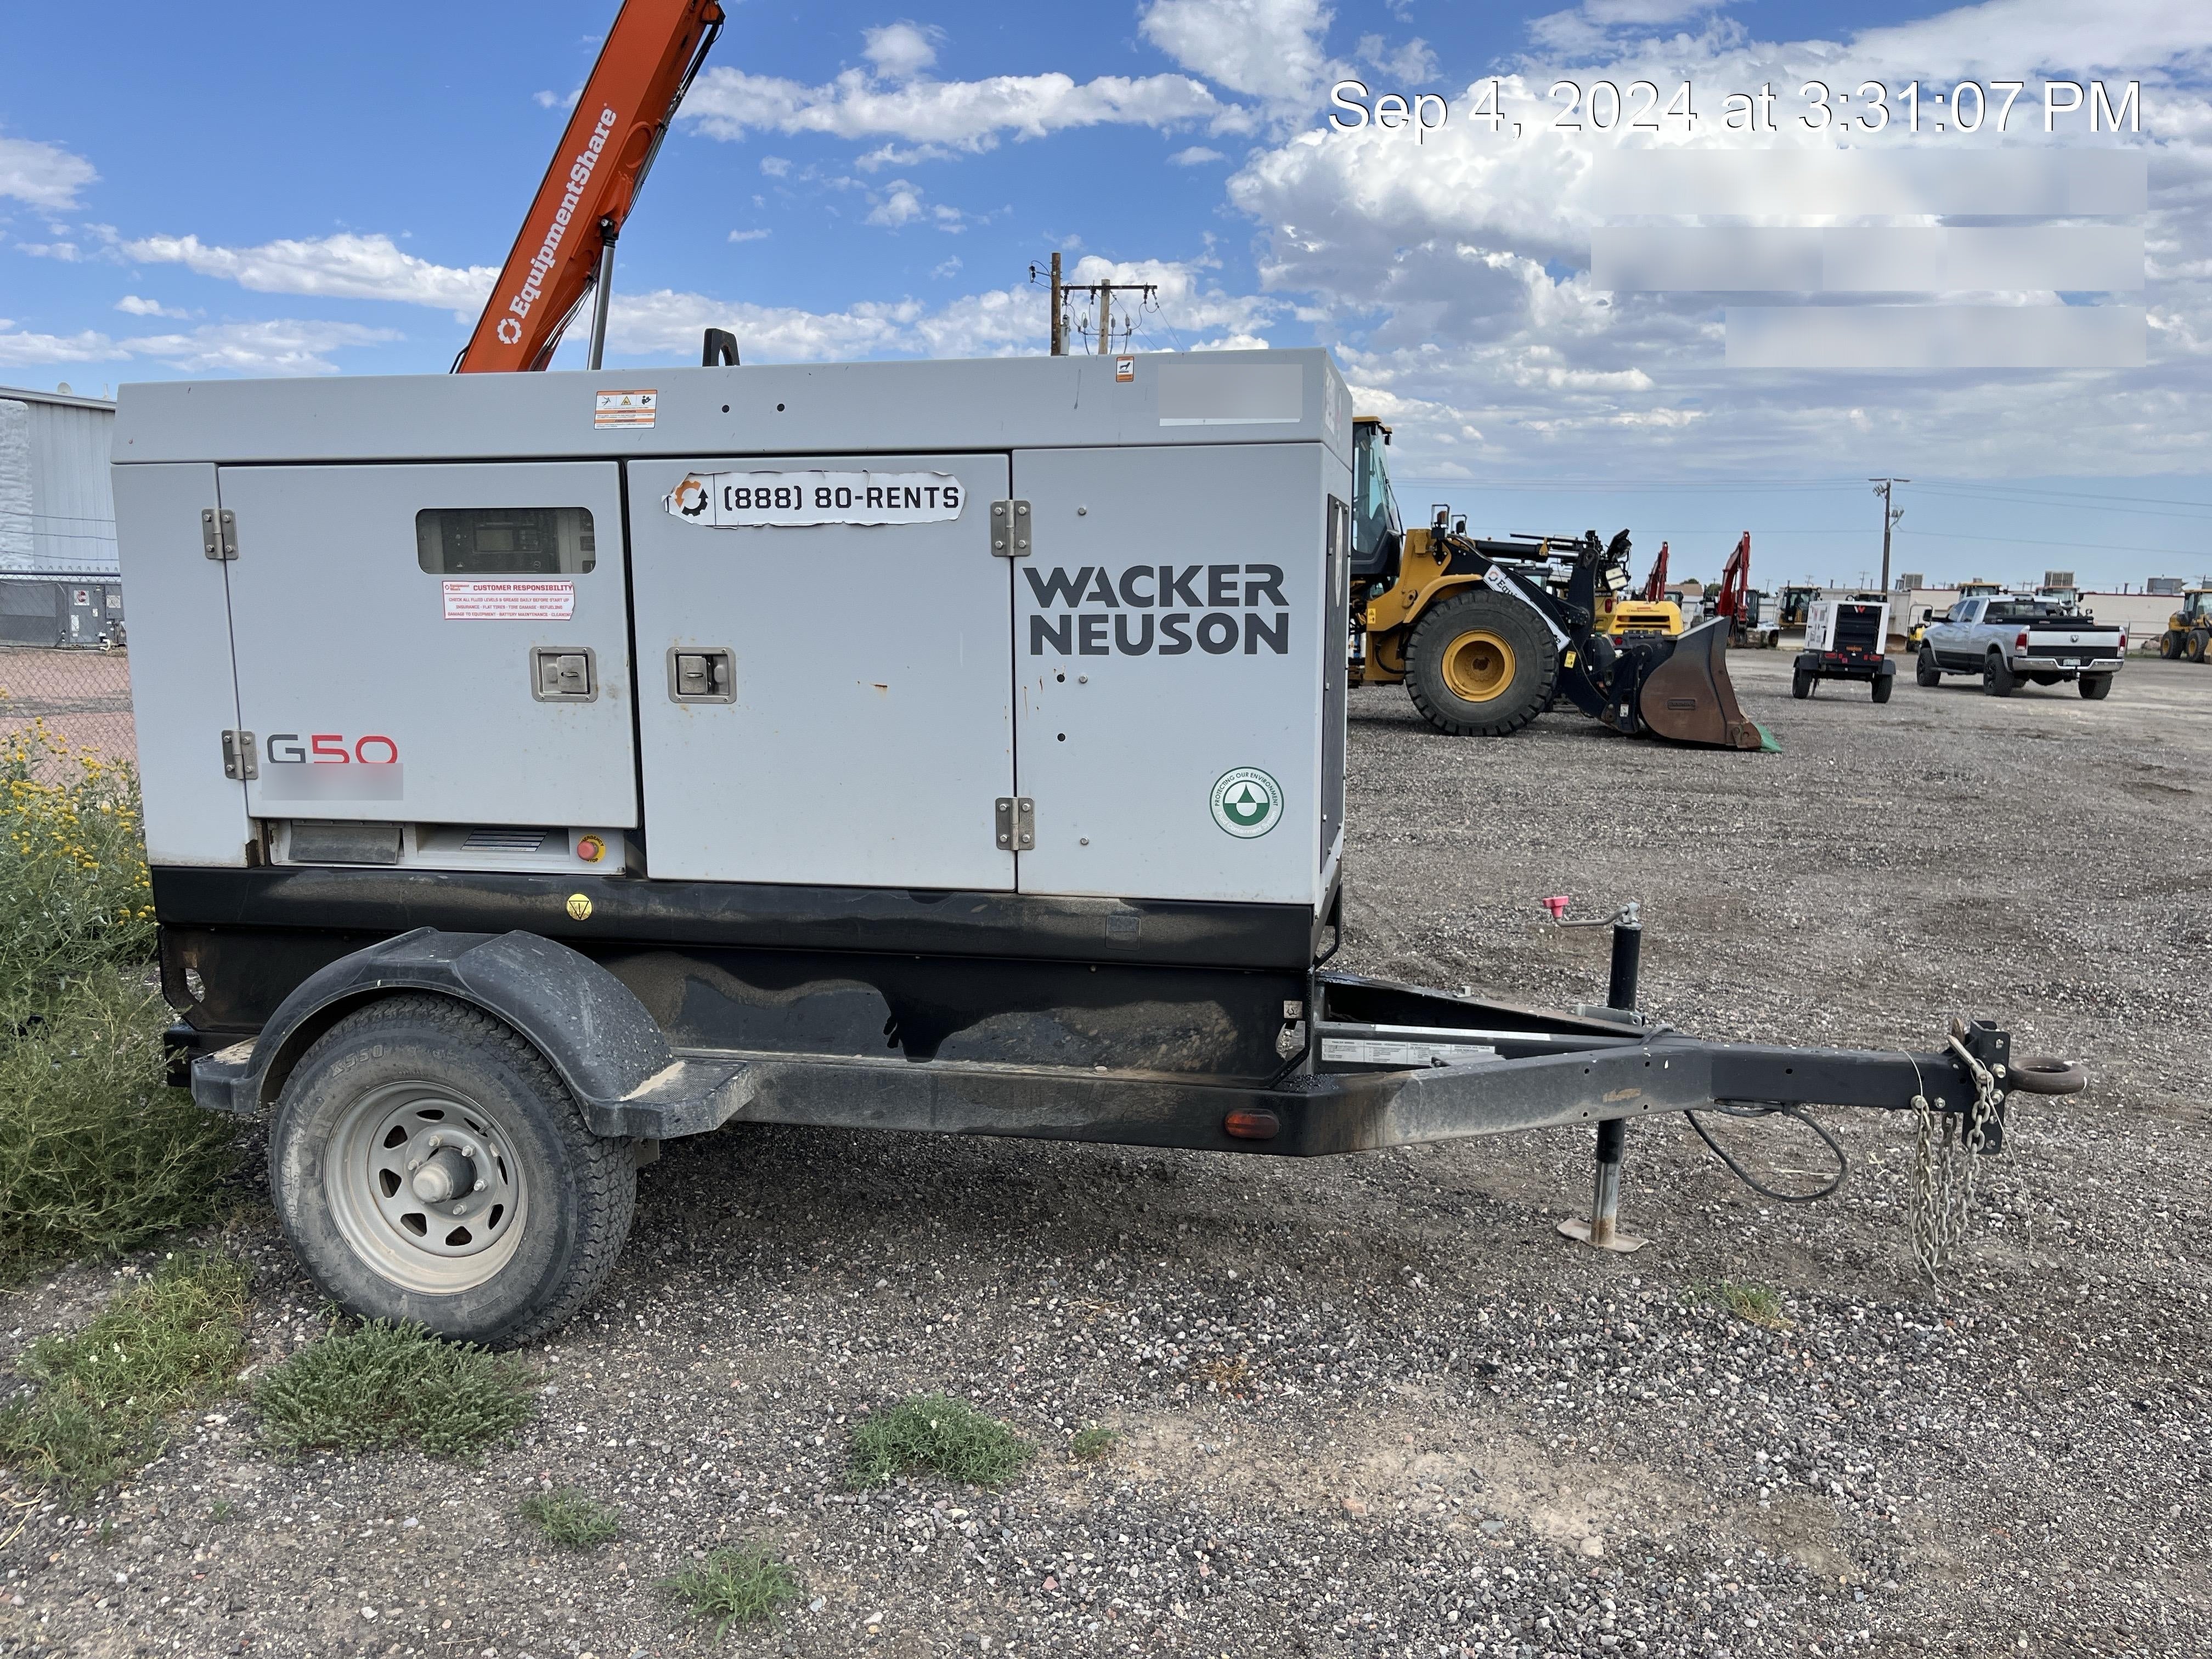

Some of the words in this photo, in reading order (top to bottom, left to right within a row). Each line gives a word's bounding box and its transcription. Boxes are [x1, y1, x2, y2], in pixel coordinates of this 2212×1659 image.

[509, 108, 618, 319] EquipmentShare
[724, 485, 803, 511] (888)
[815, 486, 960, 509] 80-RENTS
[1022, 564, 1290, 608] WACKER
[1030, 612, 1289, 656] NEUSON
[267, 734, 398, 764] G50
[1215, 775, 1235, 806] PROTECTING
[1250, 772, 1278, 806] ENVIRONMENT
[1217, 811, 1228, 825] Fluid
[330, 1045, 383, 1077] K550
